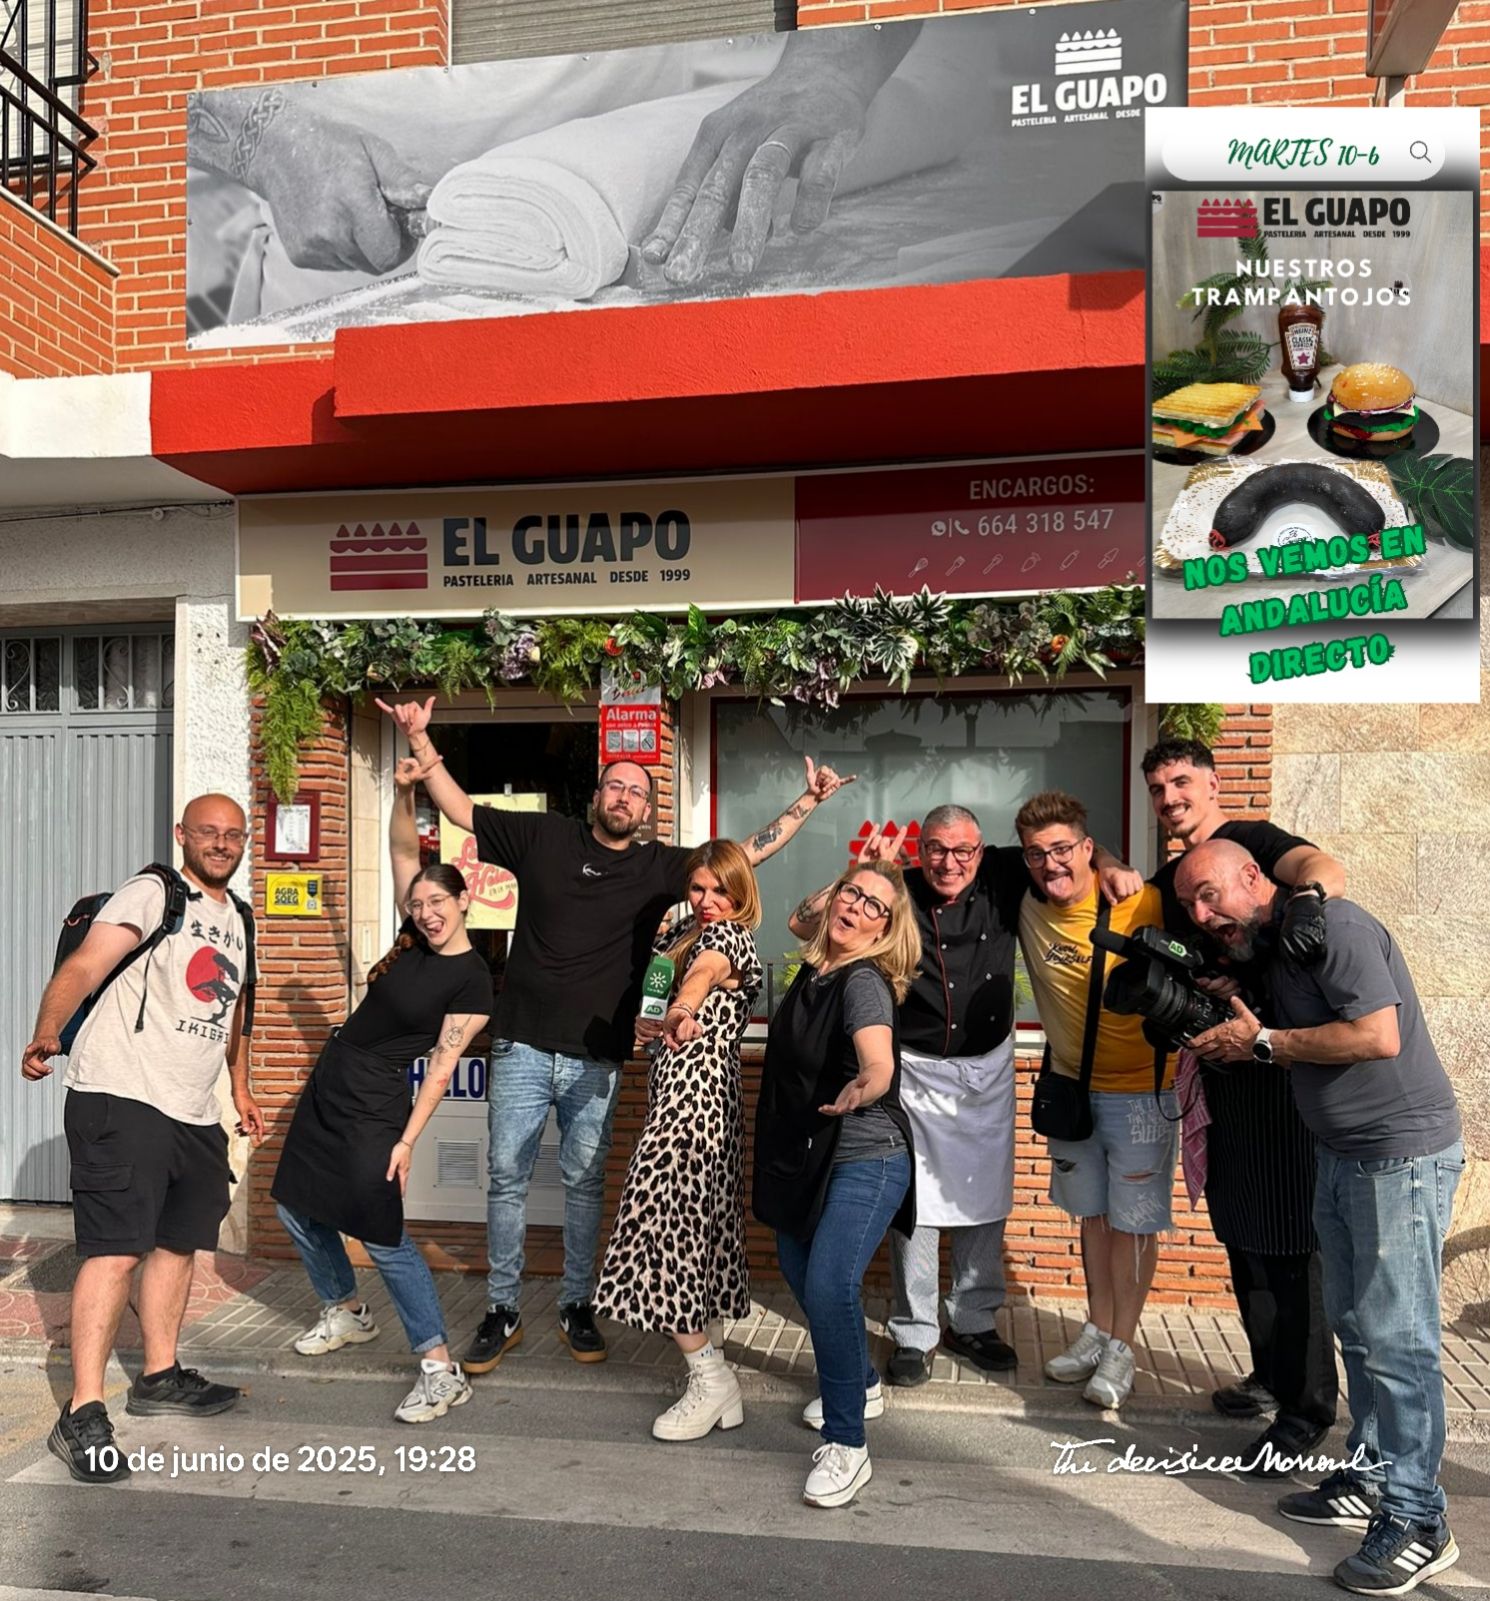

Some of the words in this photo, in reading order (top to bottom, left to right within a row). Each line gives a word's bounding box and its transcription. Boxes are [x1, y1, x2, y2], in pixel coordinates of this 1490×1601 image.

[1012, 83, 1048, 115] EL
[1055, 73, 1167, 111] GUAPO
[1012, 116, 1057, 127] PASTELERIA
[1064, 111, 1109, 123] ARTESANAL
[1115, 108, 1141, 119] DESDE
[969, 474, 1095, 500] ENCARGOS:
[977, 513, 1018, 537] 664
[1026, 511, 1065, 534] 318
[1073, 509, 1114, 532] 547
[443, 517, 500, 566] EL
[511, 510, 691, 565] GUAPO
[443, 574, 514, 587] PASTELERIA
[527, 572, 597, 586] ARTESANAL
[610, 570, 649, 583] DESDE
[660, 569, 691, 582] 1999
[606, 707, 657, 721] Alarma
[646, 1006, 660, 1014] AD
[175, 1019, 231, 1045] IKIGAI
